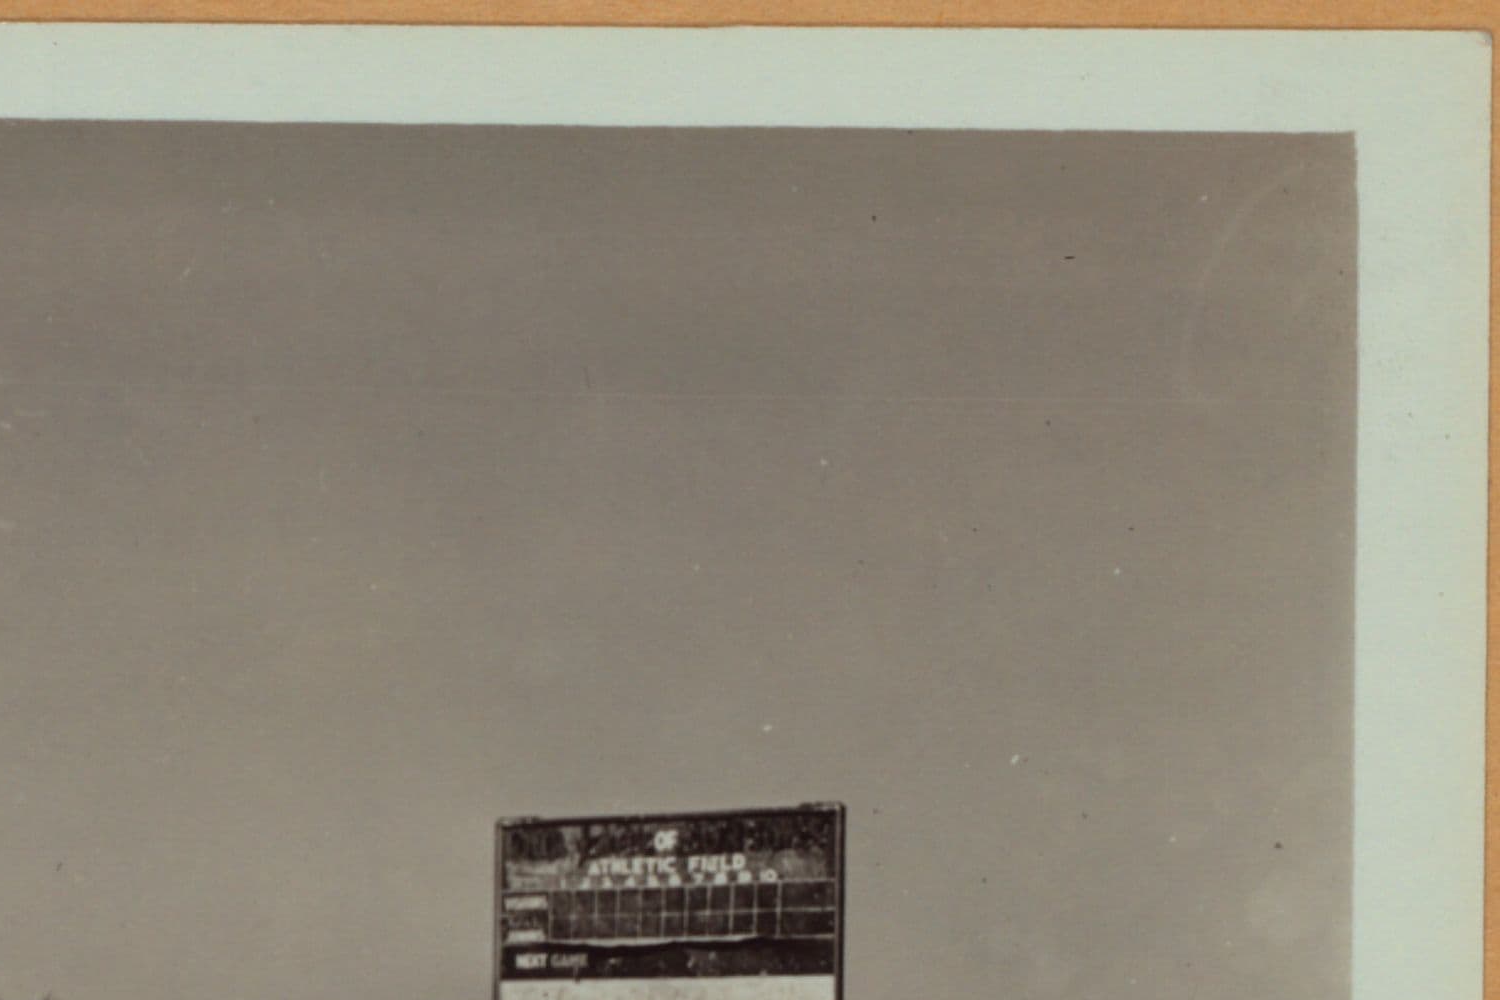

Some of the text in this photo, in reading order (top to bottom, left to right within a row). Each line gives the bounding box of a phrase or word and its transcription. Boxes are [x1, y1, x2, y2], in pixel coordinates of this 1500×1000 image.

[653, 829, 678, 851] OF
[587, 852, 746, 876] ATHLETIC FIELD
[516, 953, 548, 969] NEXT
